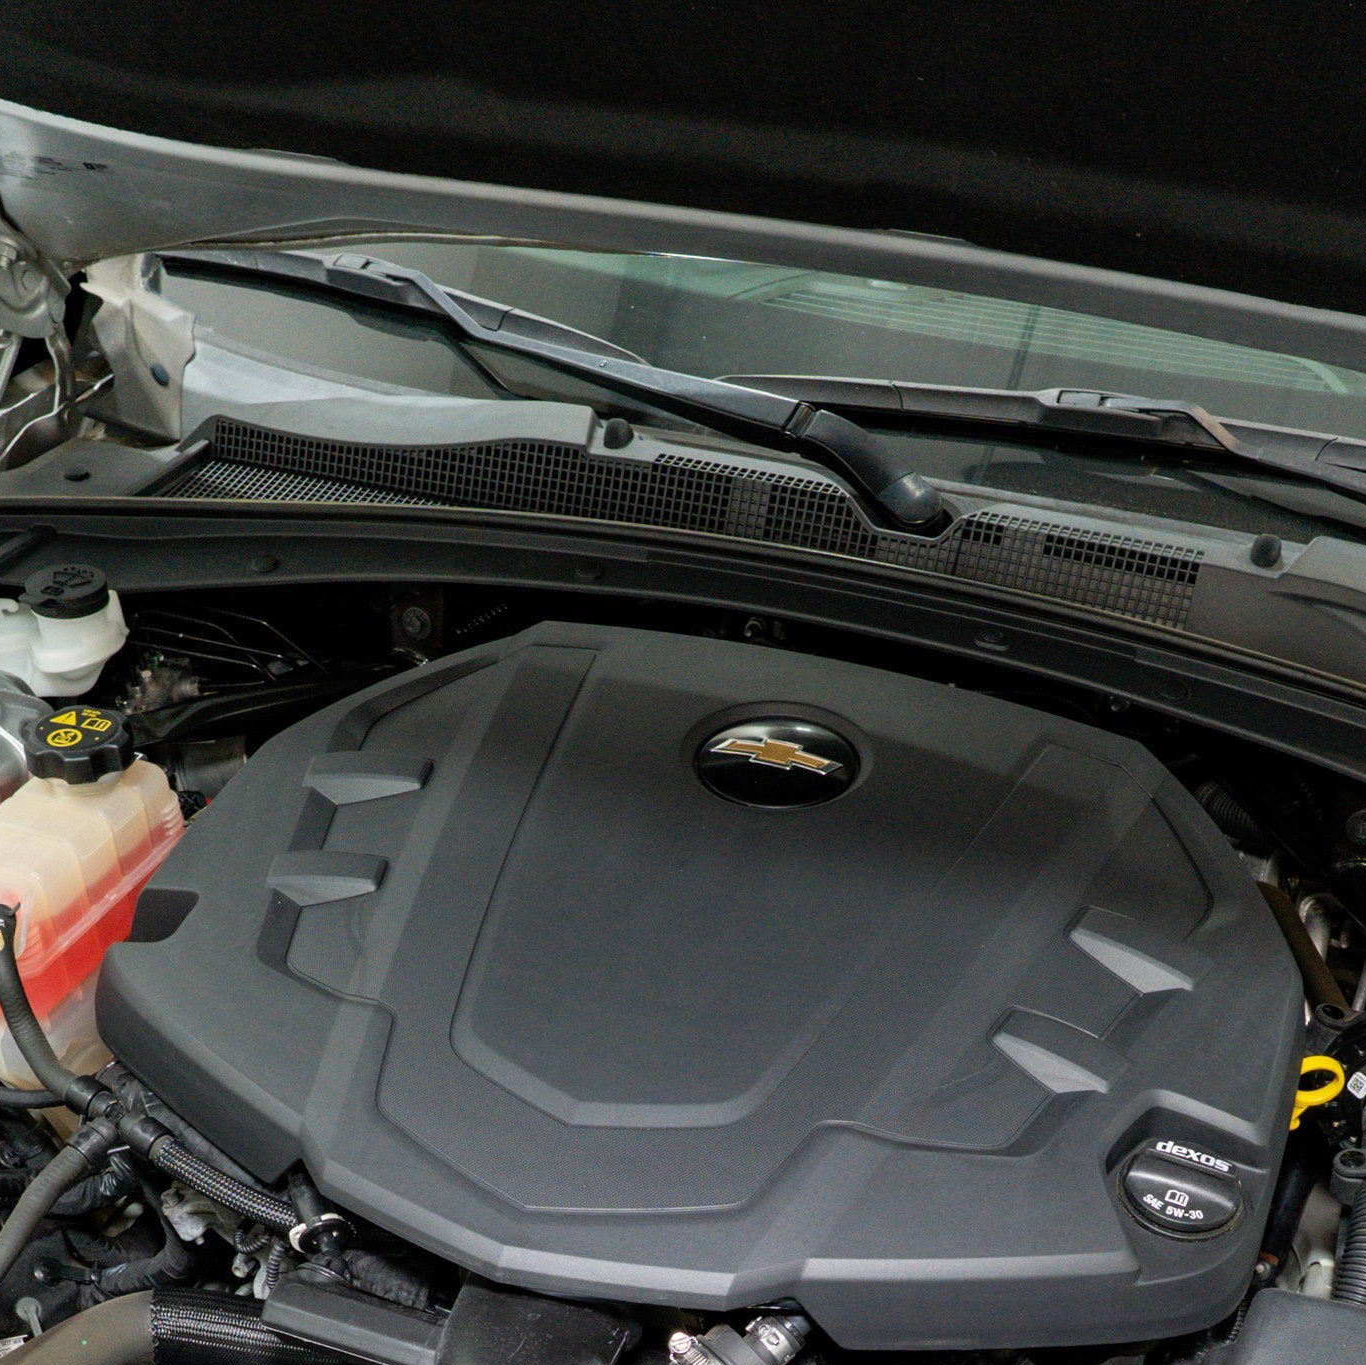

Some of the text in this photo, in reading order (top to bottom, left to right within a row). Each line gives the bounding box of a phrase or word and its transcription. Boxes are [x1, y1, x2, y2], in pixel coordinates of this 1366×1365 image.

[1156, 1140, 1232, 1172] dexos
[1143, 1194, 1204, 1220] SAE 5W-30
